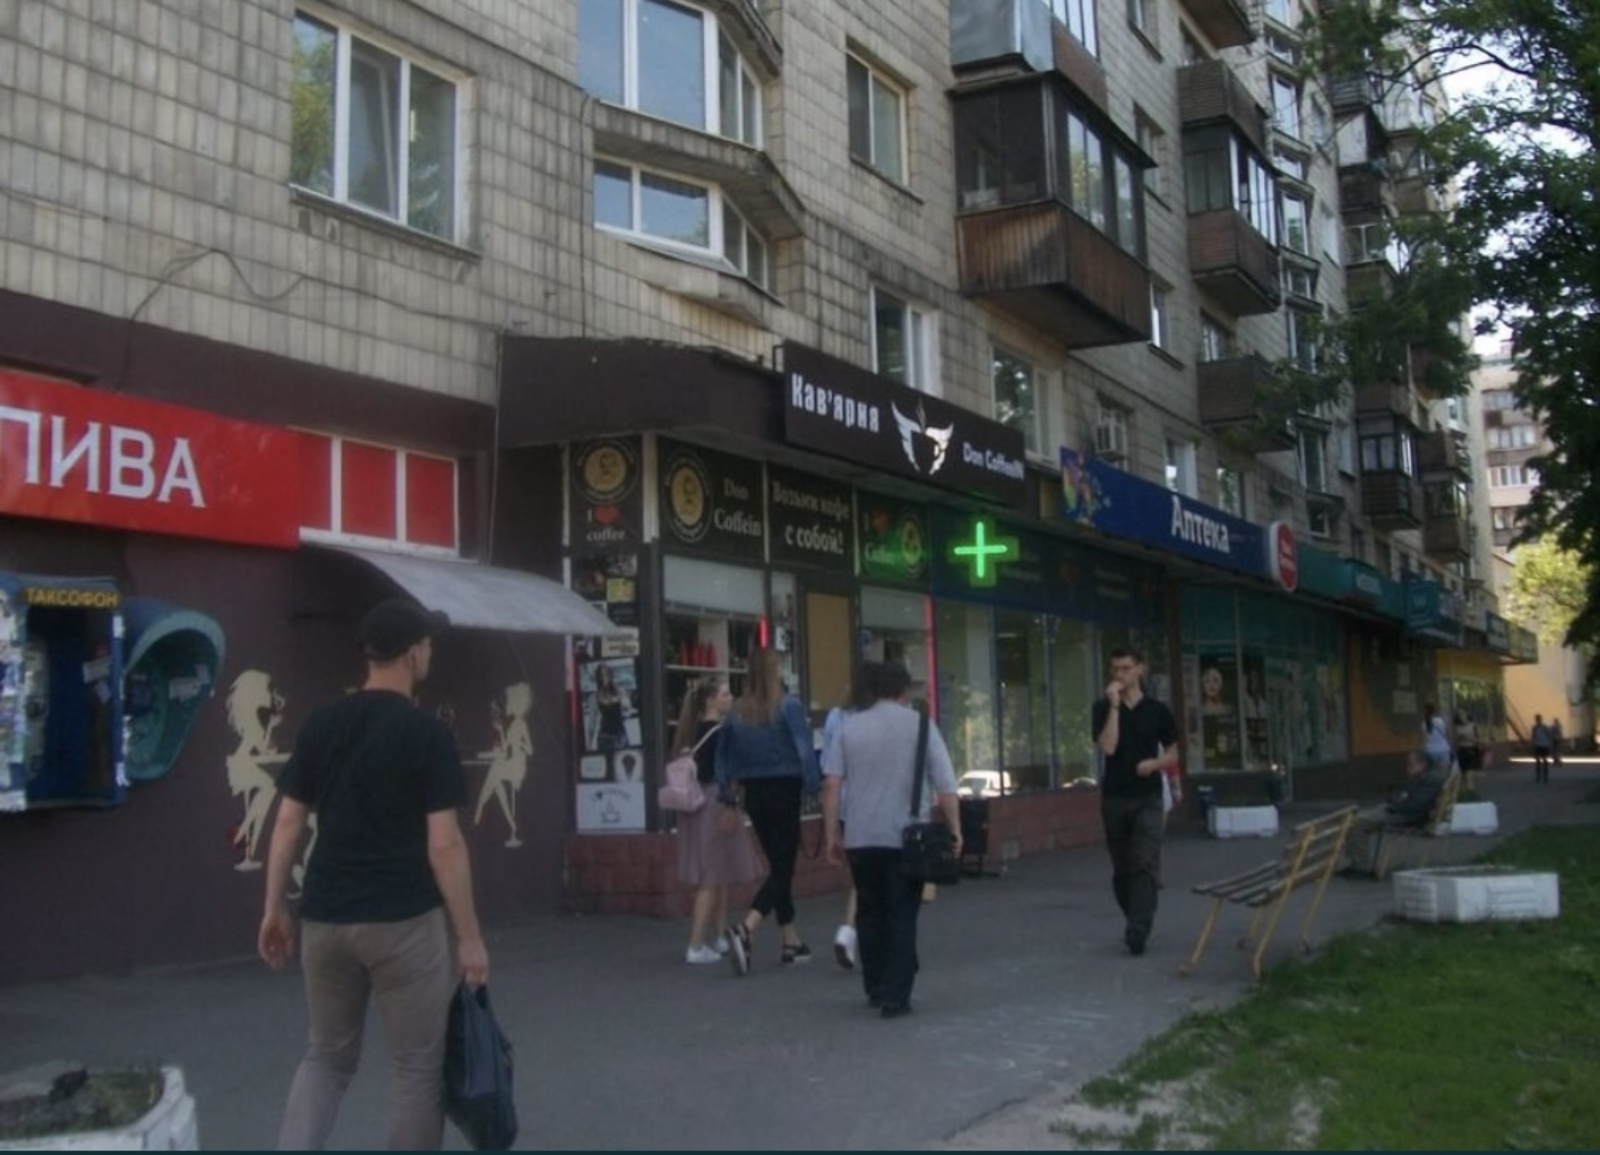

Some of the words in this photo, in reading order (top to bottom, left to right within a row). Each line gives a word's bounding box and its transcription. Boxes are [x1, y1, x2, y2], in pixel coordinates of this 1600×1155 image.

[963, 442, 984, 467] Don
[723, 478, 749, 500] Don
[586, 526, 626, 542] coffee
[714, 508, 762, 537] Coffein
[1171, 494, 1230, 553] Аптека
[796, 523, 844, 555] собой!
[26, 588, 119, 608] ТАКСОФОН
